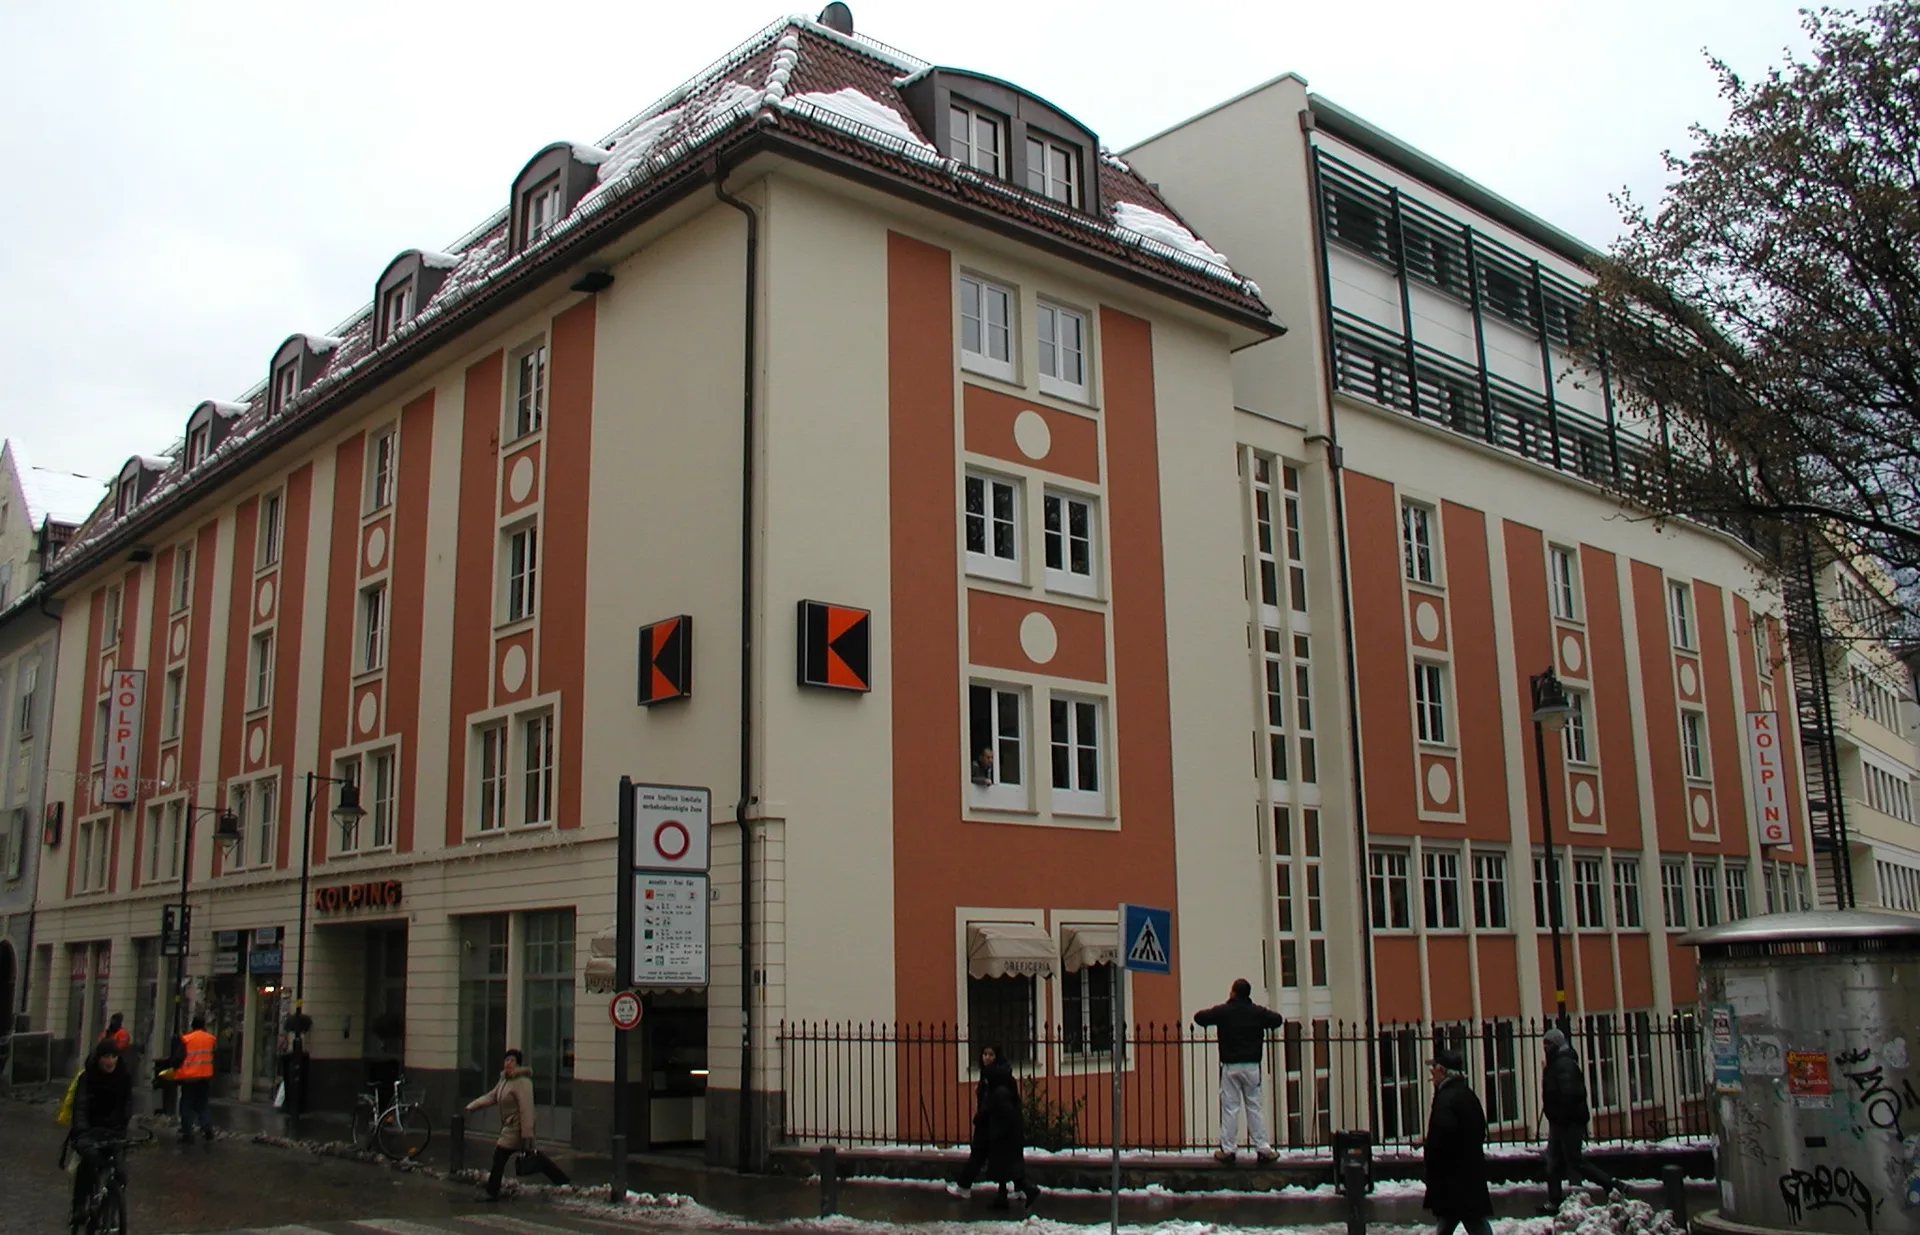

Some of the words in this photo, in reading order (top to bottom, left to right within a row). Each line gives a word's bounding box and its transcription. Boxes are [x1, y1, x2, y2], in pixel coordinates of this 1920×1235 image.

[112, 674, 136, 800] KOLPING
[1753, 714, 1783, 840] KOLPING
[315, 880, 401, 910] KOLPING
[1004, 959, 1051, 971] OREFICERIA
